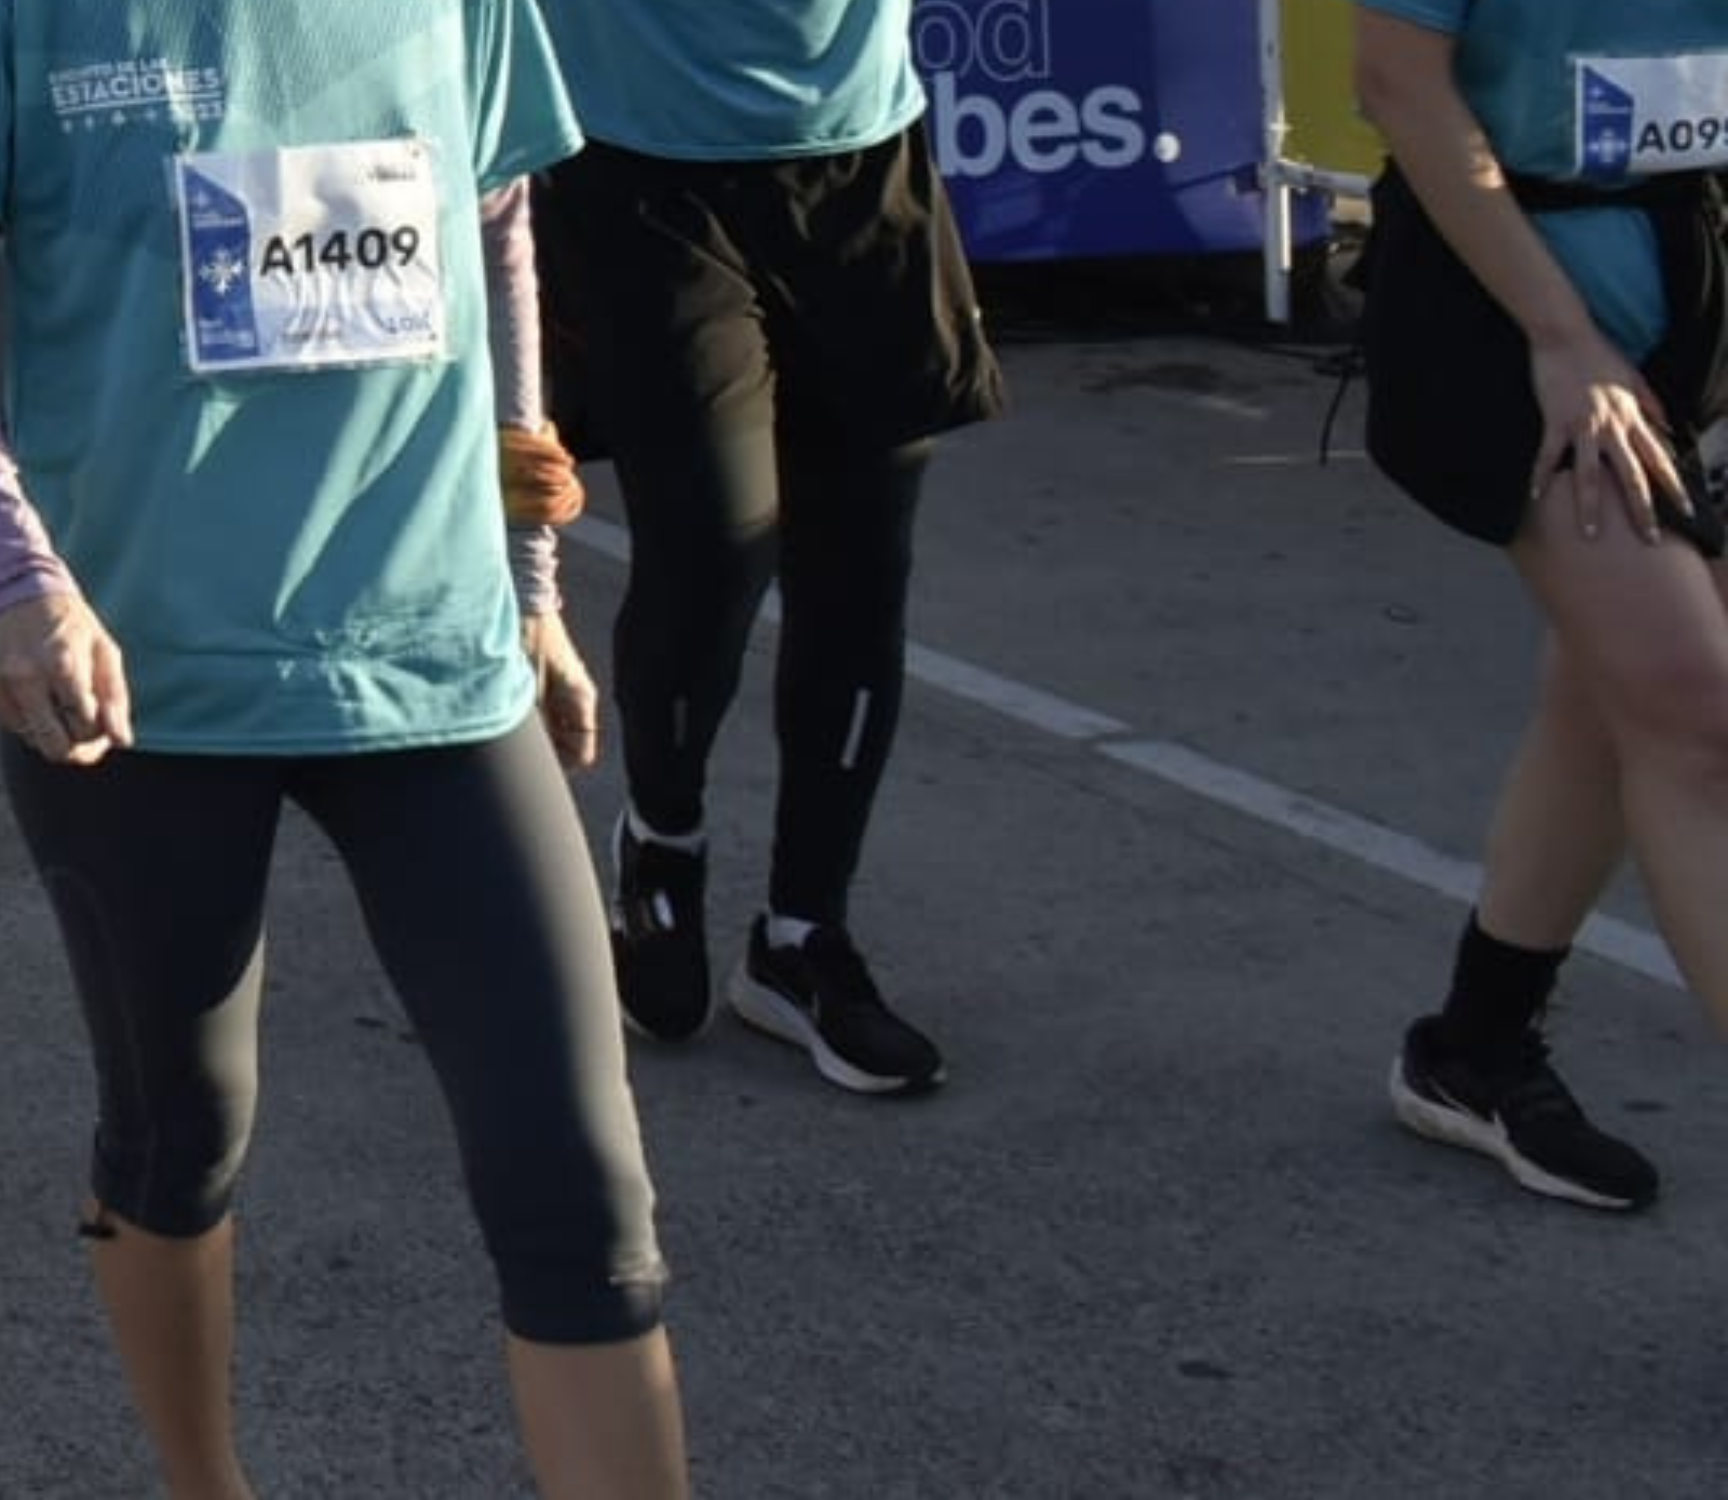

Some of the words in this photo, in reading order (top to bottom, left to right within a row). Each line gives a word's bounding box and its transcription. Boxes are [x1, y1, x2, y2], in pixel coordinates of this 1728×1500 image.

[934, 70, 1181, 177] bes.
[1636, 117, 1728, 153] A09
[260, 225, 420, 277] A1409
